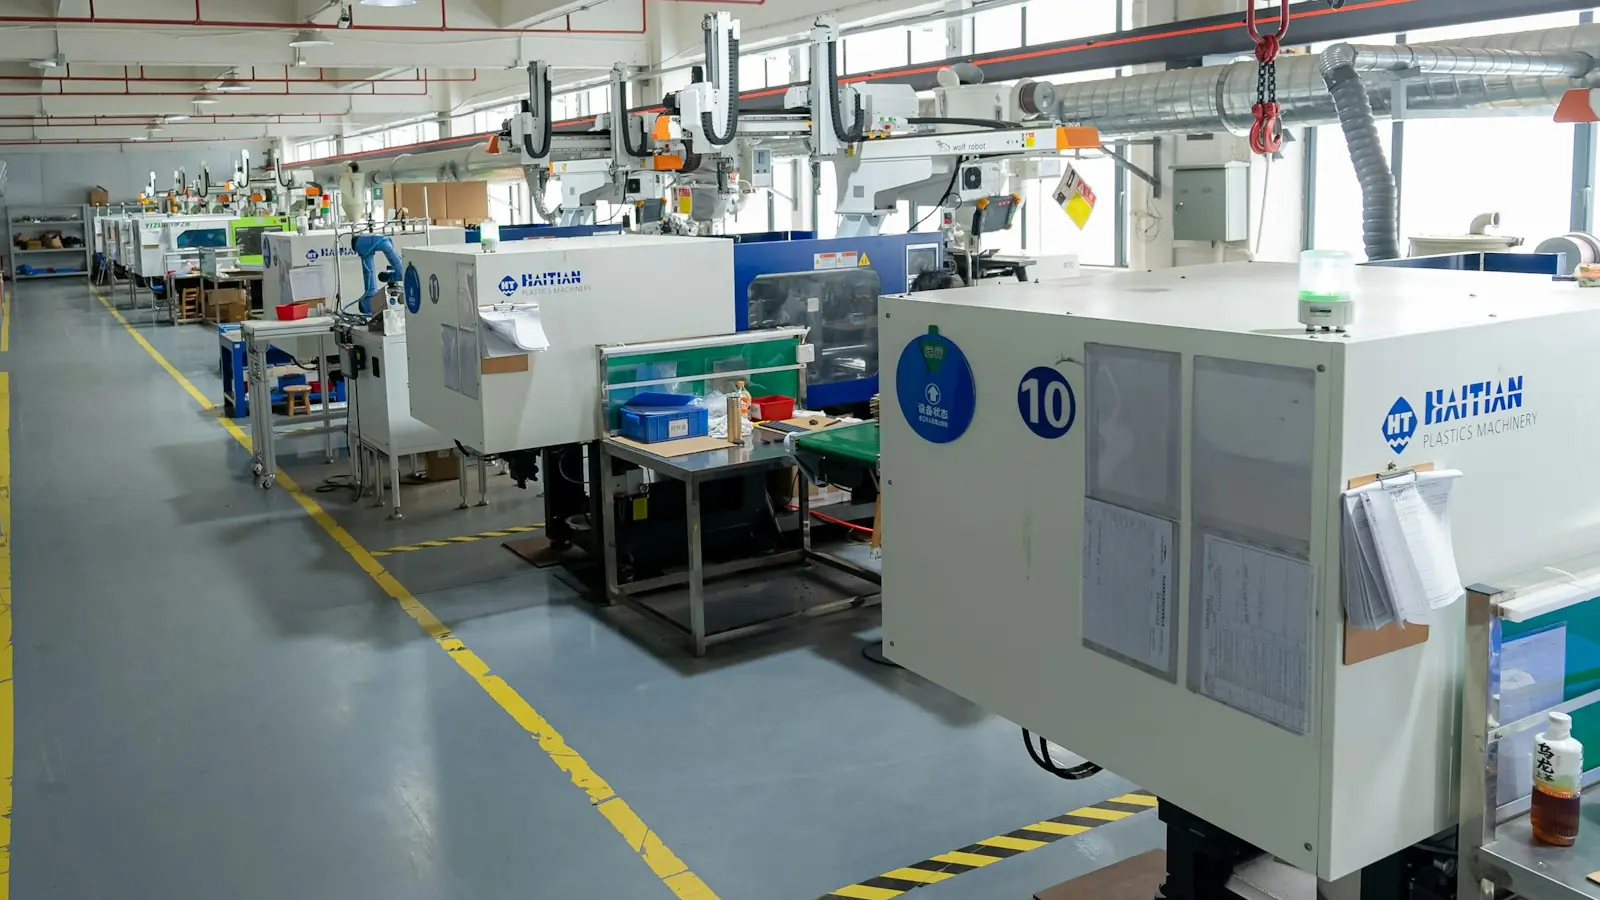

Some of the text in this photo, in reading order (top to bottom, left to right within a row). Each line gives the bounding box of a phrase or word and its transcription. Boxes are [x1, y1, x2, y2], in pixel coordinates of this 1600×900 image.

[952, 142, 986, 151] wolf robot
[429, 278, 439, 300] 11
[501, 280, 515, 290] HT
[521, 270, 581, 287] HAITIAN
[521, 285, 592, 297] PLASTICS MACHINERY
[918, 402, 949, 420] 设备状态
[1021, 377, 1071, 429] 10
[1424, 375, 1523, 426] HAITIAN
[1387, 411, 1413, 436] HT
[1423, 412, 1539, 449] PLASTICS MACHINERY
[1537, 742, 1555, 774] 乌龙
